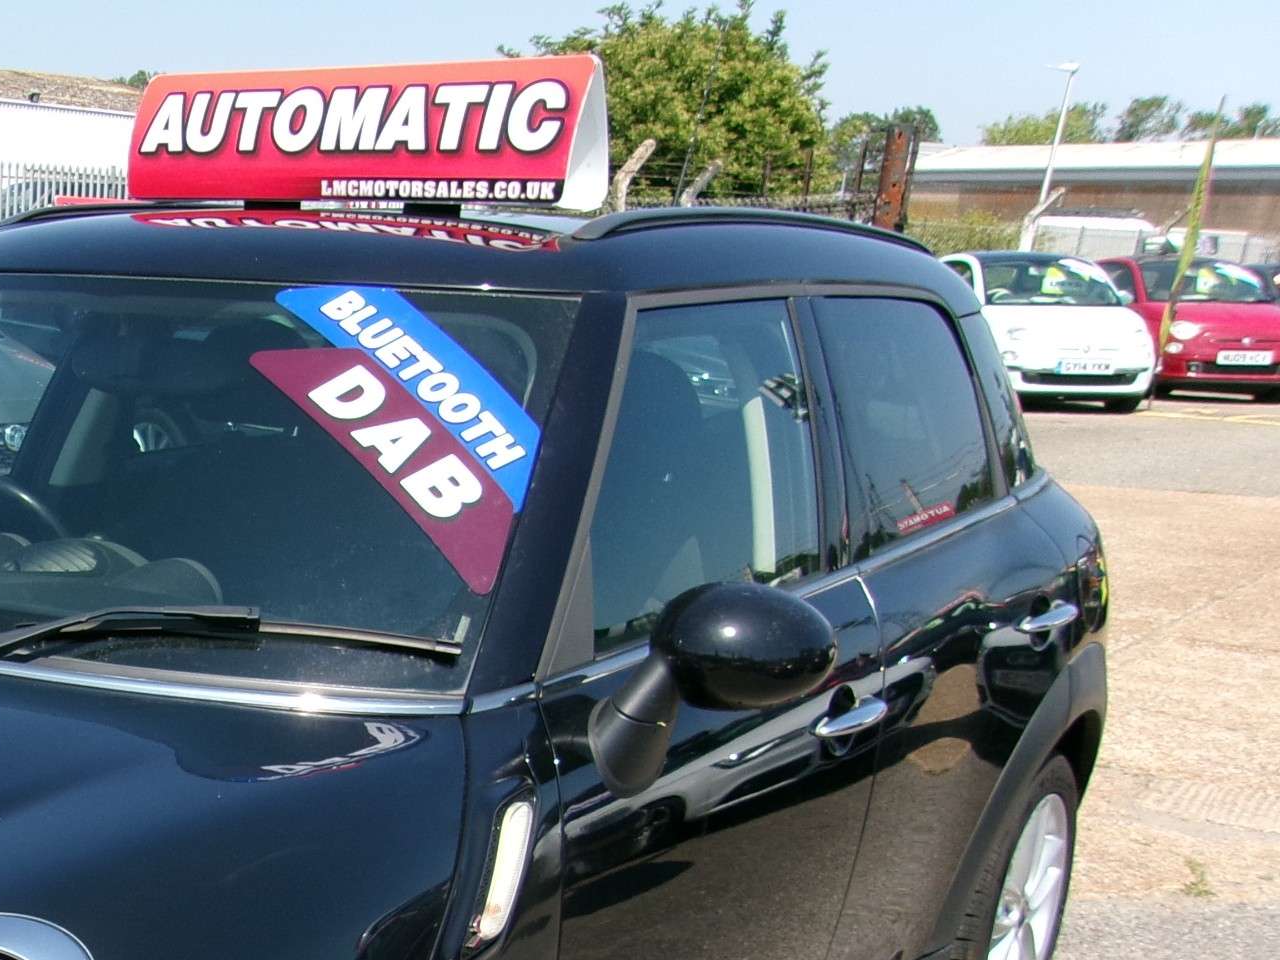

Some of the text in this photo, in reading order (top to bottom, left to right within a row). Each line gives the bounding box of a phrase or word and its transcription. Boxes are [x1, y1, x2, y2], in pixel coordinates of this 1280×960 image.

[138, 79, 568, 155] AUTOMATIC
[320, 180, 556, 199] LMCMOTORSALES.CO.UK
[320, 289, 527, 471] BLUETOOTH
[307, 364, 483, 518] DAB
